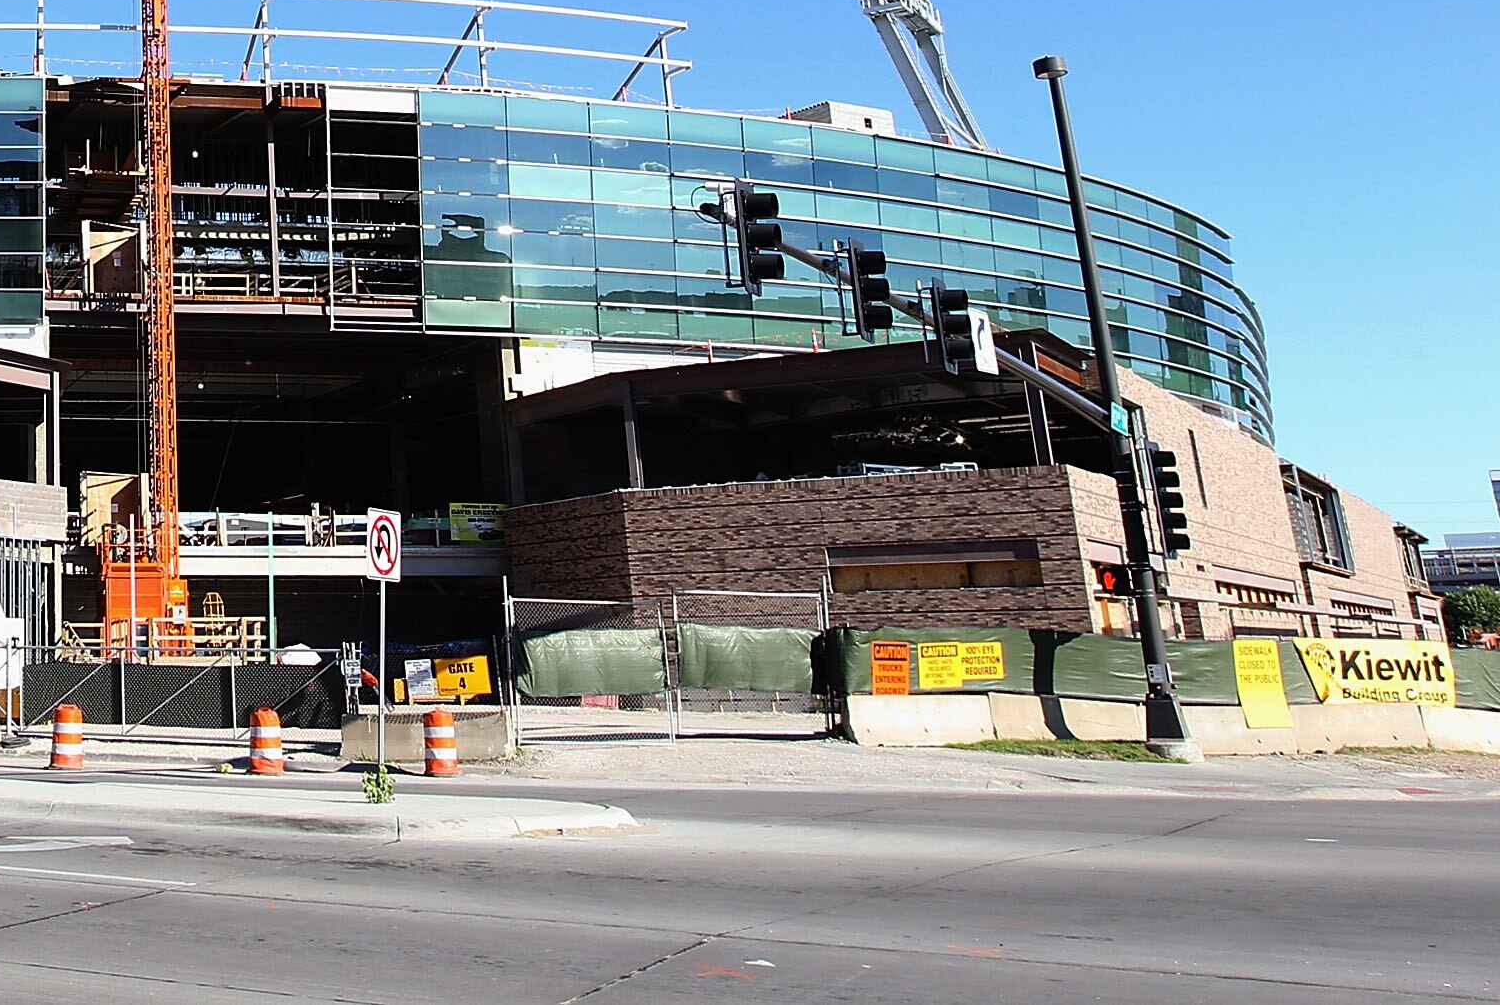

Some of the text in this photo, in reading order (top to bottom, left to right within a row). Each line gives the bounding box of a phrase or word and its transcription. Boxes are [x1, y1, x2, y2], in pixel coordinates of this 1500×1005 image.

[874, 645, 908, 658] CAUTION
[922, 646, 957, 657] CAUTION
[982, 645, 995, 654] EYE
[1238, 646, 1273, 655] SIDEWALK
[961, 656, 1000, 665] PROTECTION
[1239, 660, 1276, 670] CLOSED TO
[448, 662, 475, 674] GATE
[878, 664, 903, 672] TRUCKS
[965, 666, 998, 675] REQUIRED
[1339, 650, 1445, 682] Kiewit
[459, 677, 466, 690] 4
[875, 675, 906, 684] ENTERING
[1239, 674, 1279, 684] THE PUBLIC
[875, 687, 905, 695] ROADWAY
[1342, 688, 1400, 702] Building
